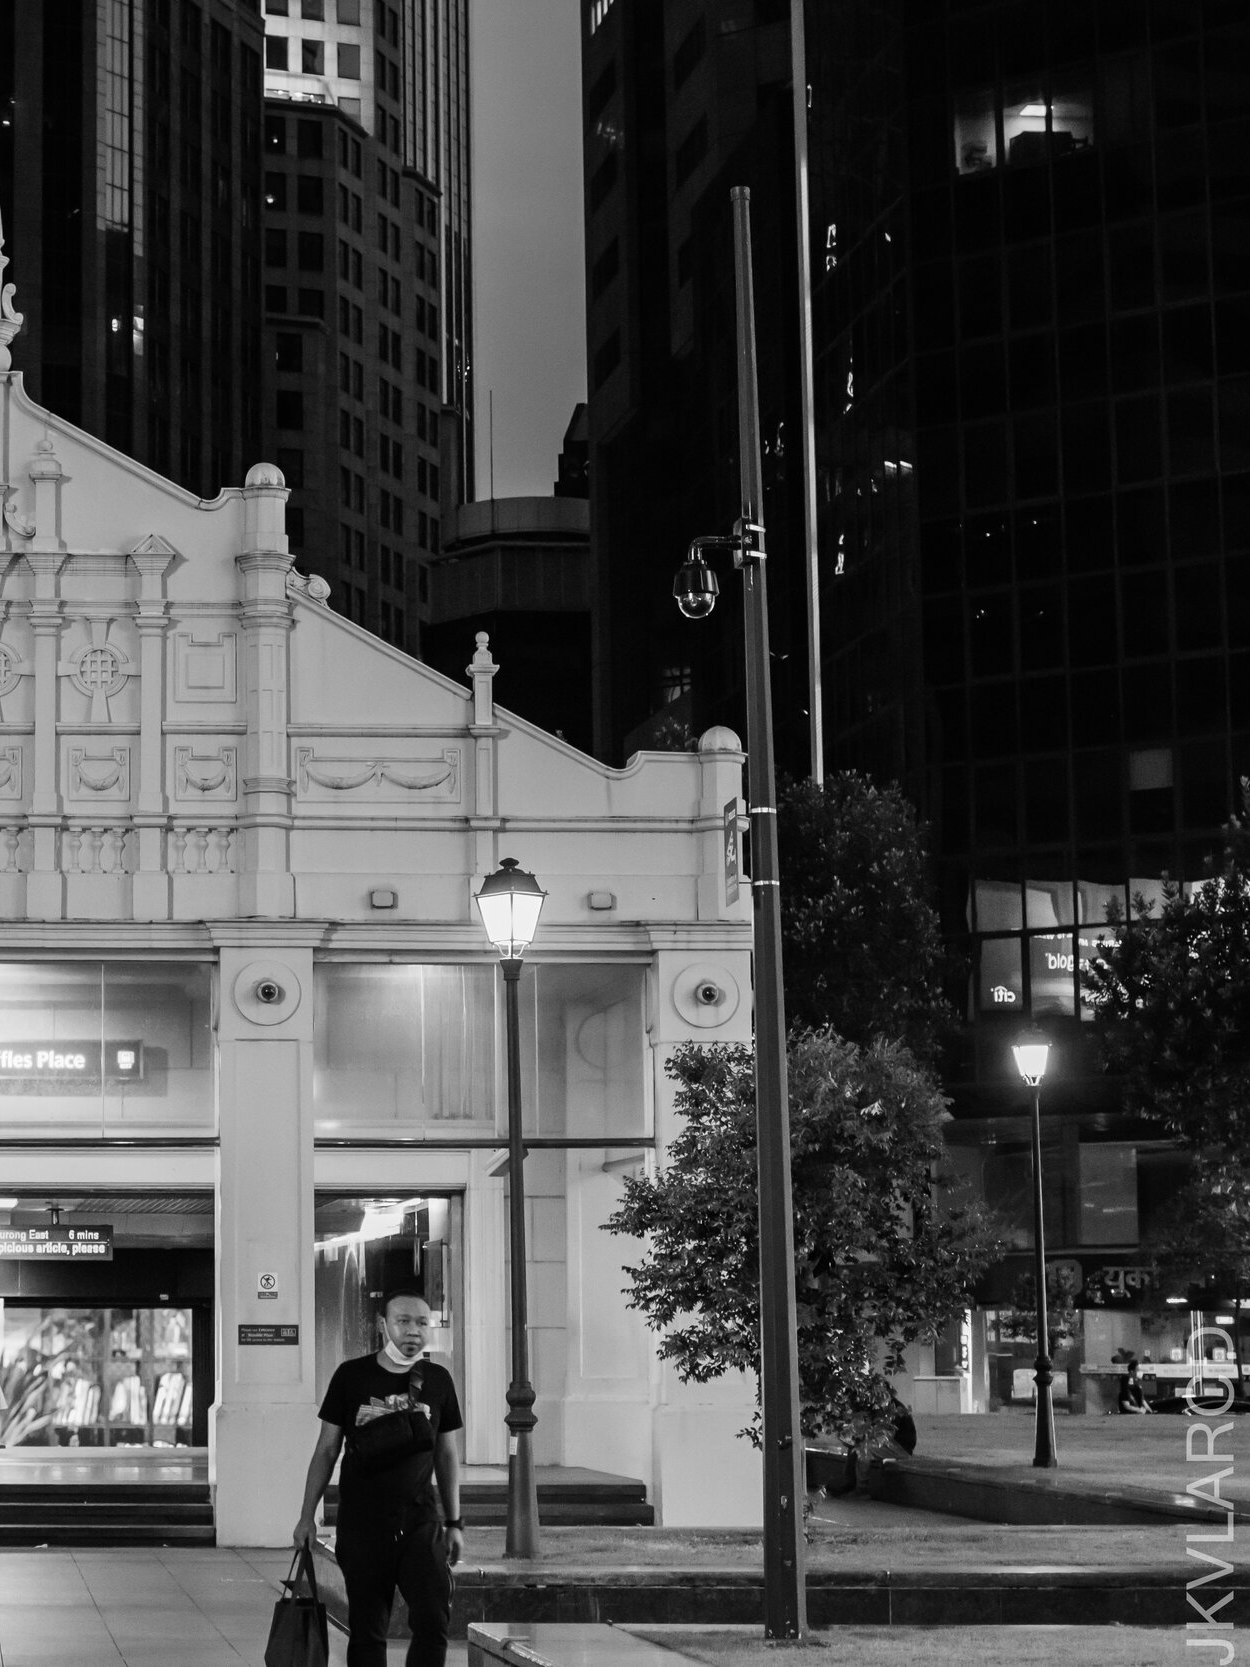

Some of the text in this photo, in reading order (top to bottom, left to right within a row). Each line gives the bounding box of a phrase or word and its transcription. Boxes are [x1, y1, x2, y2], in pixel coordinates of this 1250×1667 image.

[36, 1050, 86, 1069] Place
[29, 1229, 49, 1240] East
[68, 1229, 75, 1240] 6
[76, 1229, 99, 1240] mins
[36, 1242, 70, 1256] article,
[72, 1242, 106, 1256] please
